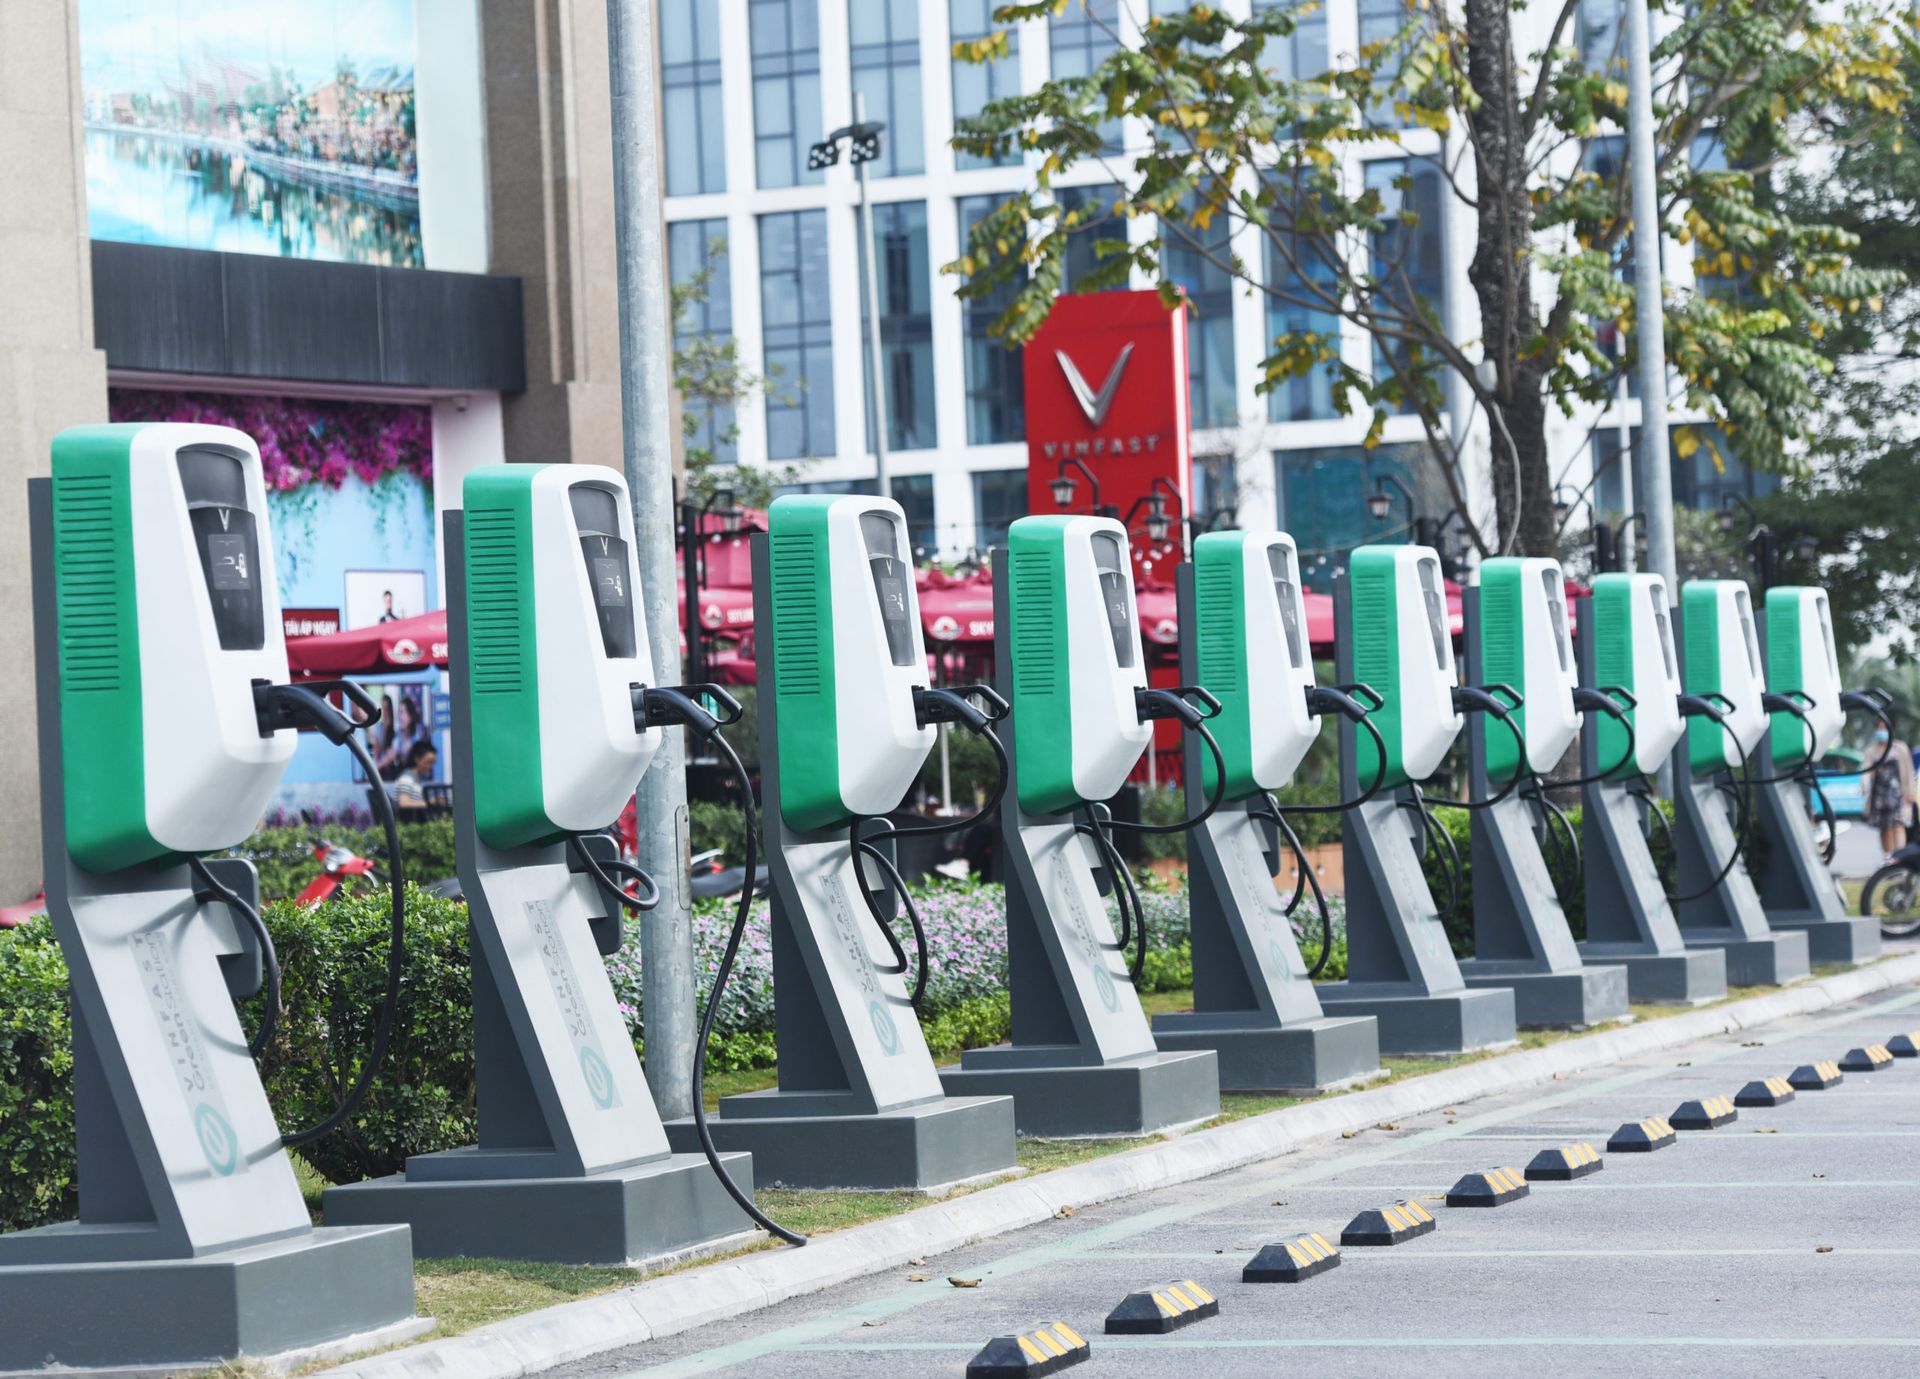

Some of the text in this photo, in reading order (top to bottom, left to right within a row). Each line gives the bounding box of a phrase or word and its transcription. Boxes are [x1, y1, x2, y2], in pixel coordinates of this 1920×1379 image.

[1043, 434, 1159, 459] VINFAST
[132, 933, 194, 1093] VINFAST
[526, 901, 578, 1038] VINFAST
